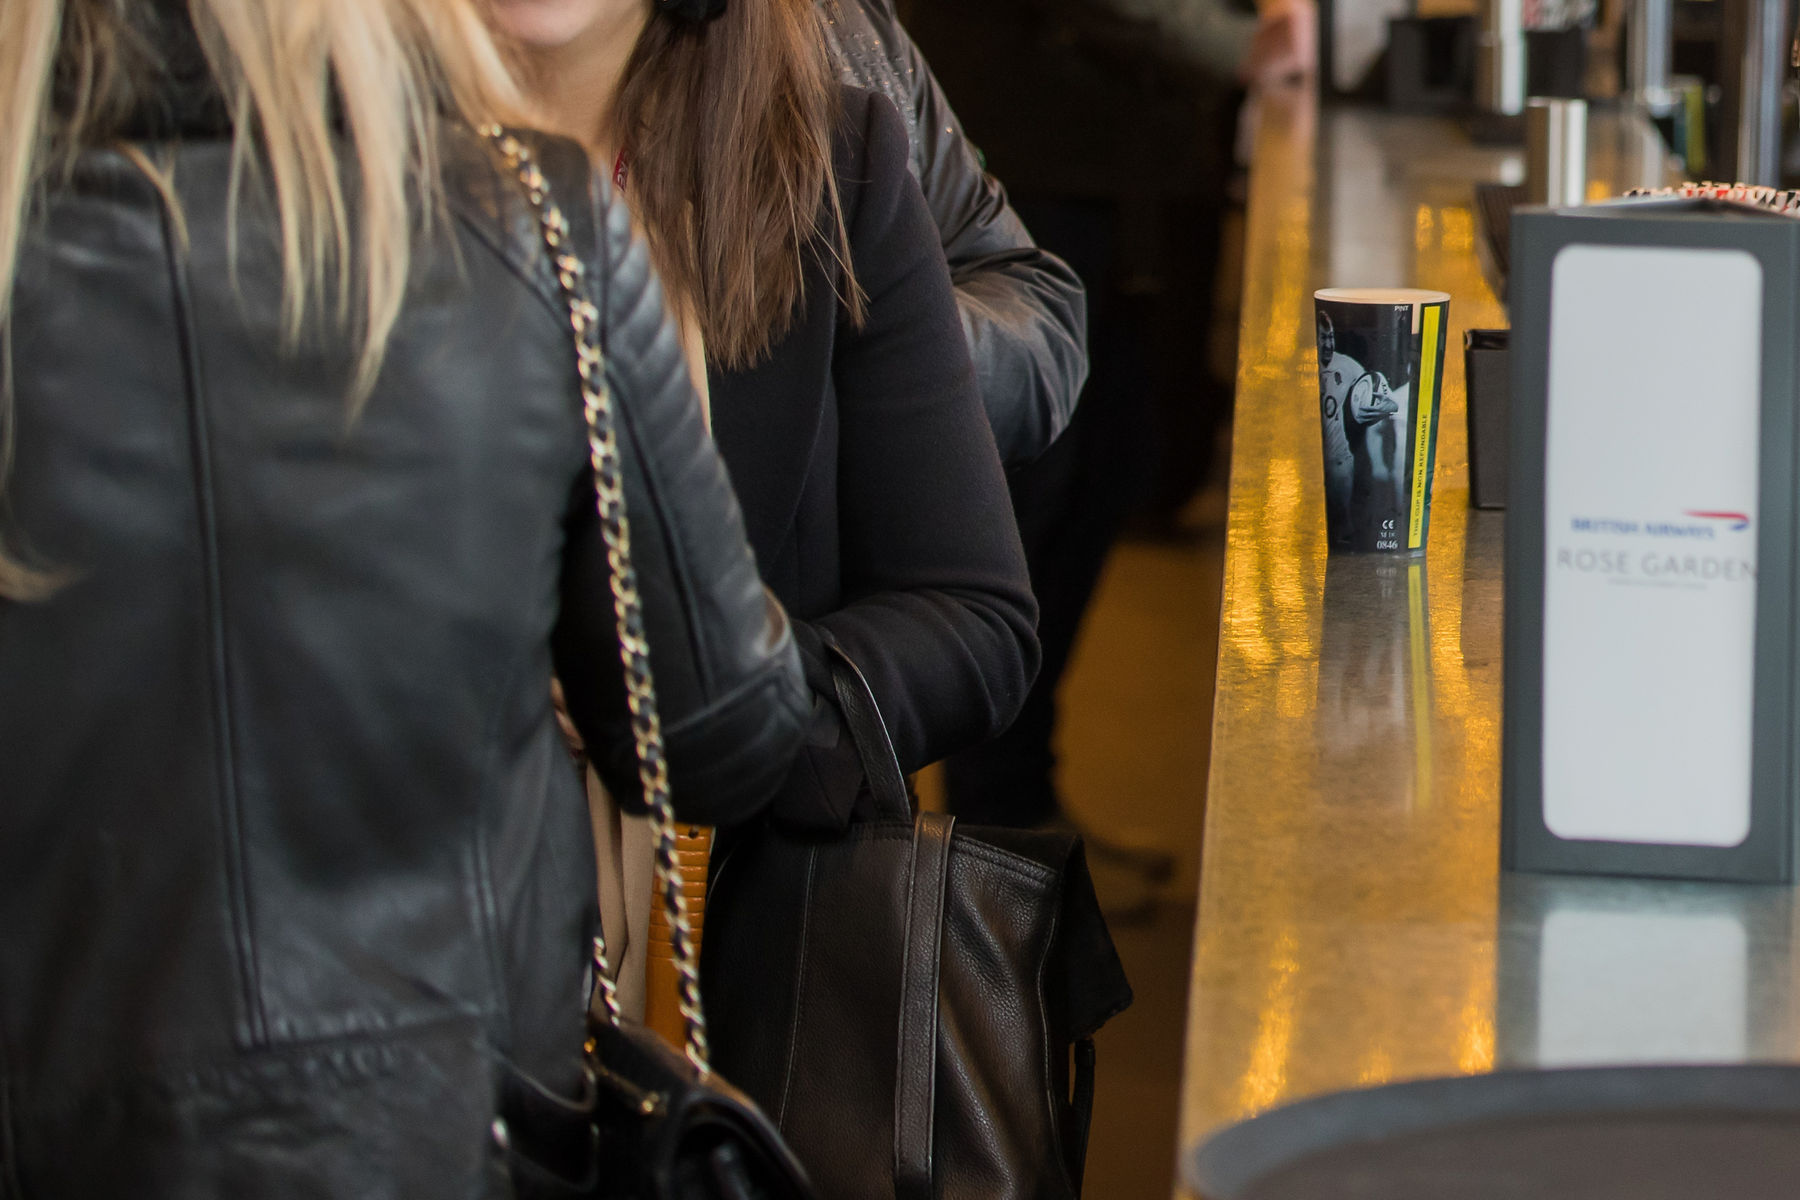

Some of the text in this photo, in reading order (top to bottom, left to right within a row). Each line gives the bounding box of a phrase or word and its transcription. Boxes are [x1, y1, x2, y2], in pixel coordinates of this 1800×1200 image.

[1418, 413, 1427, 467] REFUNDABLE
[1570, 517, 1716, 539] BRITISH AIRWAYS
[1376, 540, 1399, 550] 0846
[1556, 547, 1630, 574] ROSE
